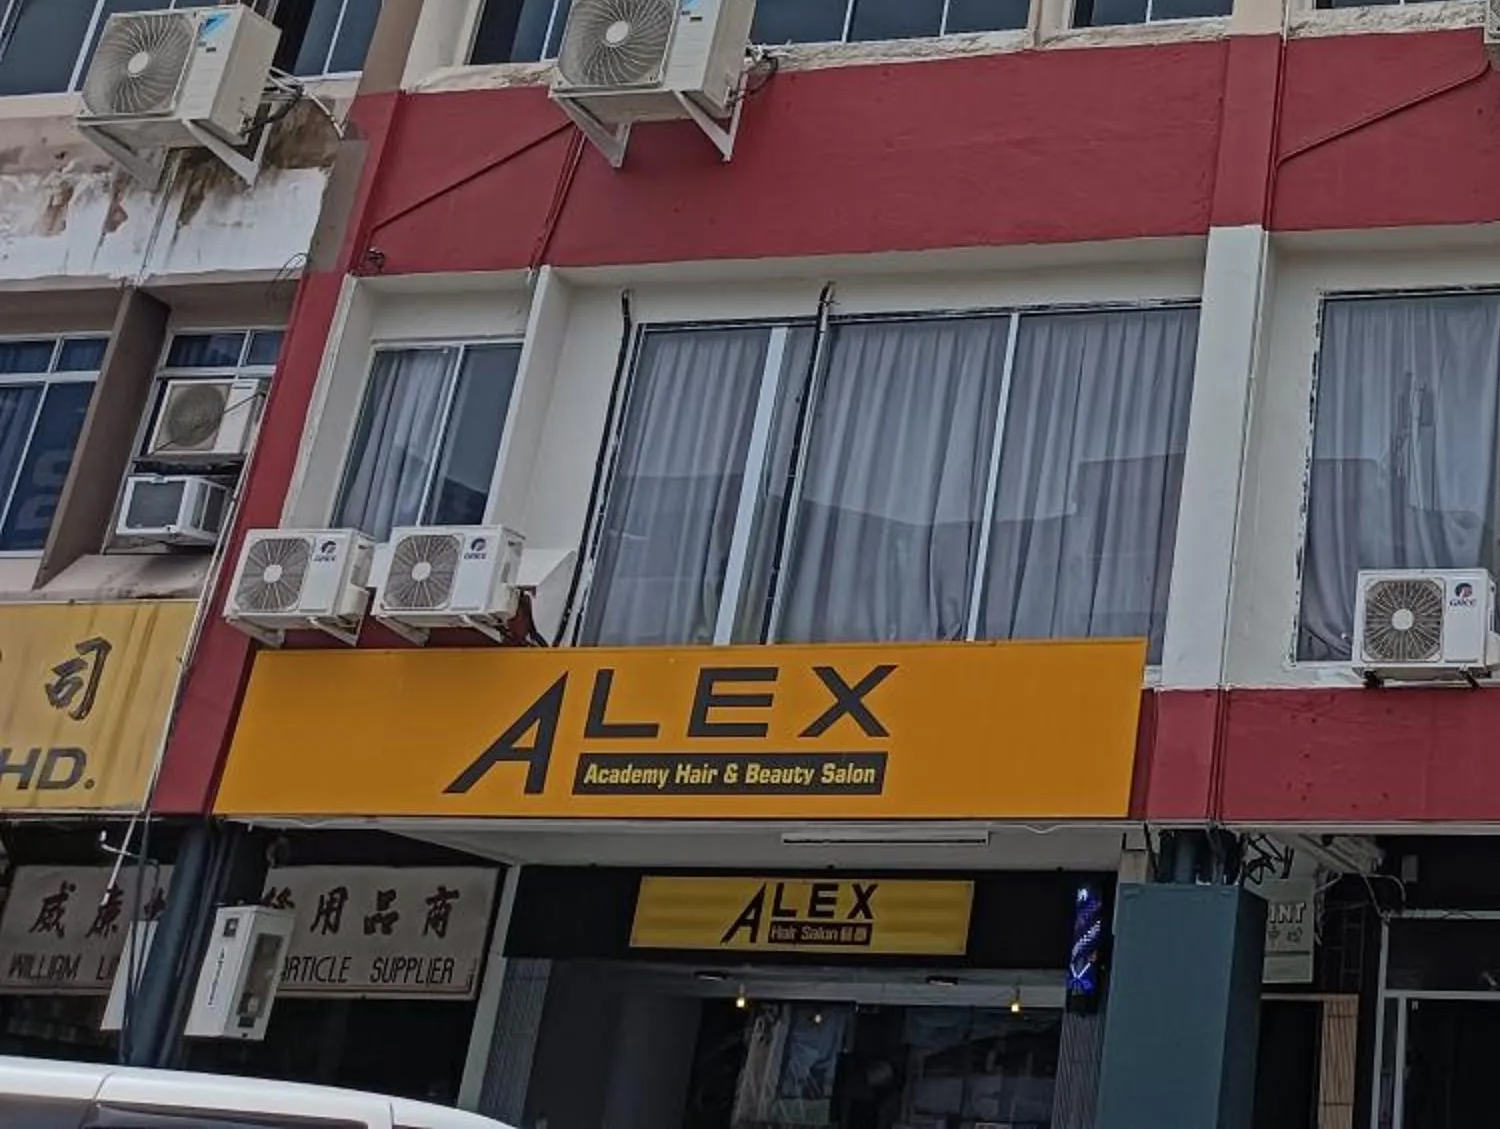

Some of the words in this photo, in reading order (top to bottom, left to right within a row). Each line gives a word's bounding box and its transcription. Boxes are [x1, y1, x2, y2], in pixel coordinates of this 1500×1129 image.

[44, 636, 113, 720] 司
[441, 664, 899, 796] ALEX
[584, 762, 670, 789] Academy
[675, 762, 719, 784] Hair
[723, 762, 739, 784] &
[745, 762, 814, 787] Beauty
[820, 761, 876, 784] Salon
[719, 881, 879, 945] ALEX
[771, 923, 797, 941] Hair
[800, 924, 839, 941] Salon
[369, 955, 456, 985] SUPPLIER
